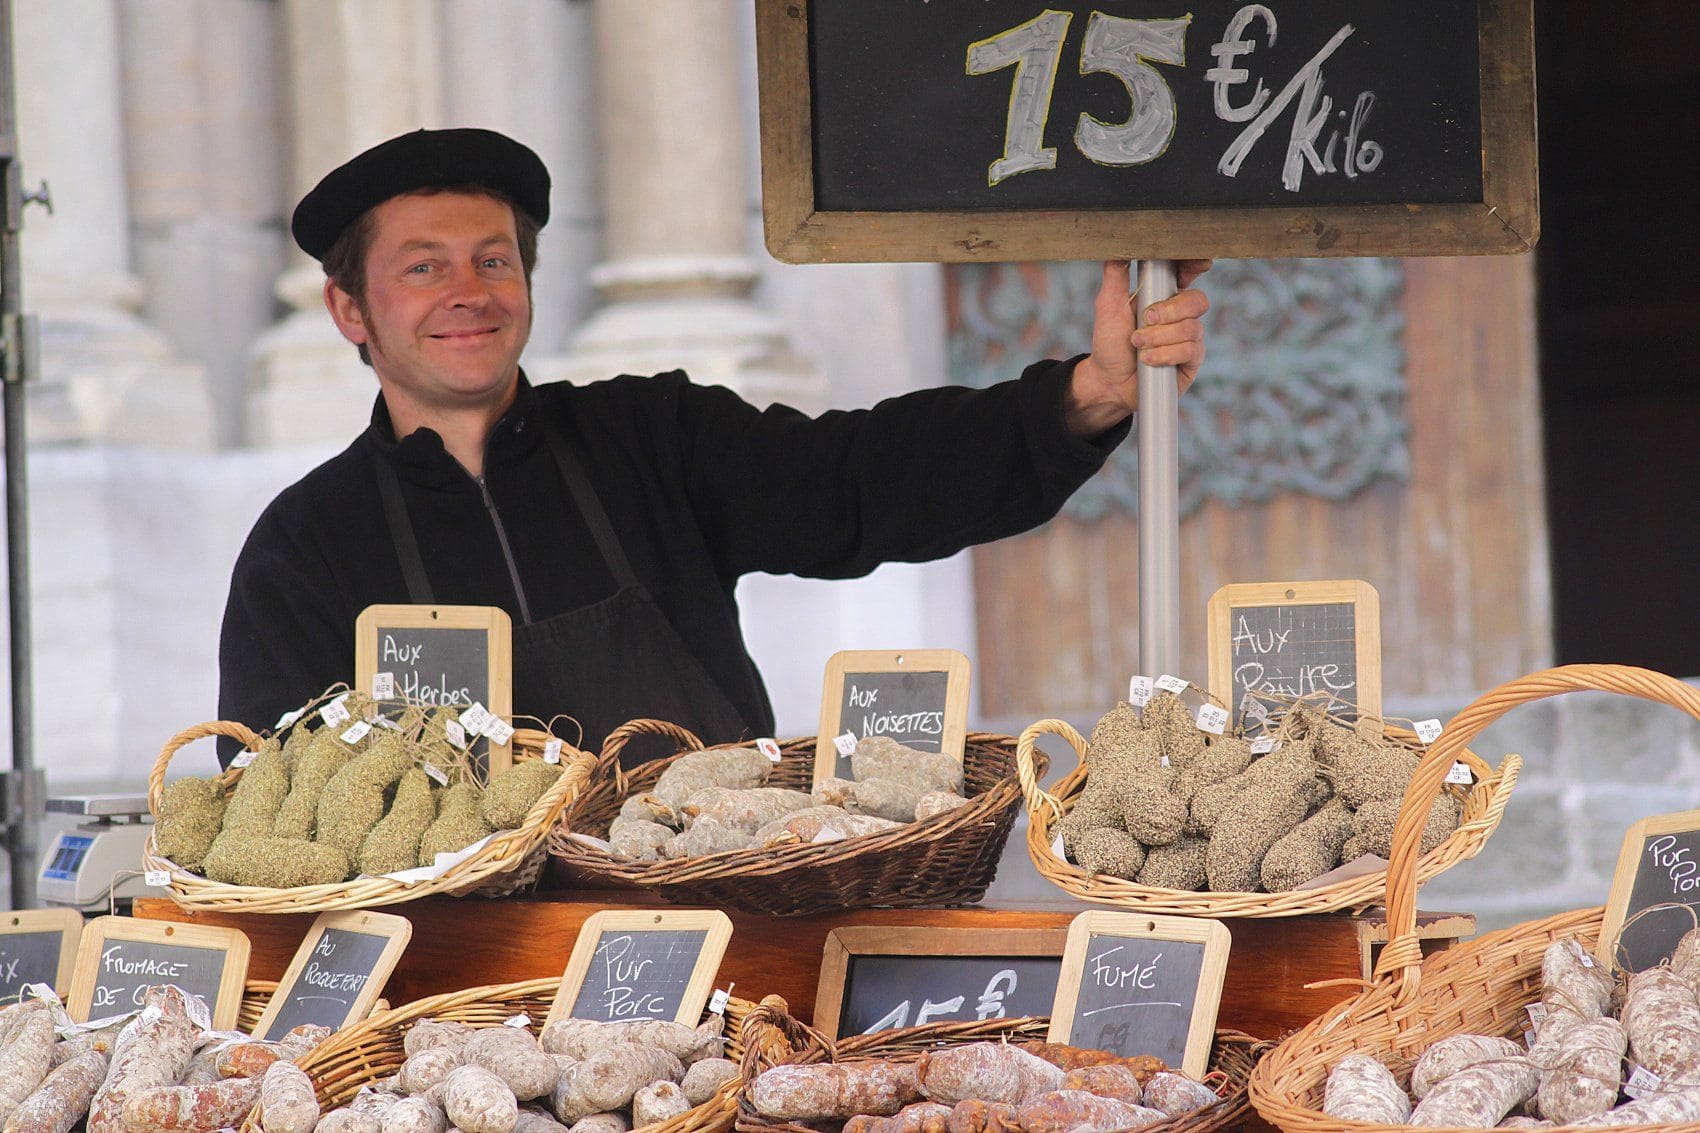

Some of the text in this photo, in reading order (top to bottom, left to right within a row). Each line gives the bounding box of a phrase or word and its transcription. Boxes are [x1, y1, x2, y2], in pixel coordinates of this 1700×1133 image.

[404, 670, 473, 706] Herbes
[1648, 835, 1690, 867] Pur
[102, 945, 188, 977] FROMAGE
[93, 986, 125, 1007] DE
[603, 987, 665, 1018] Porc
